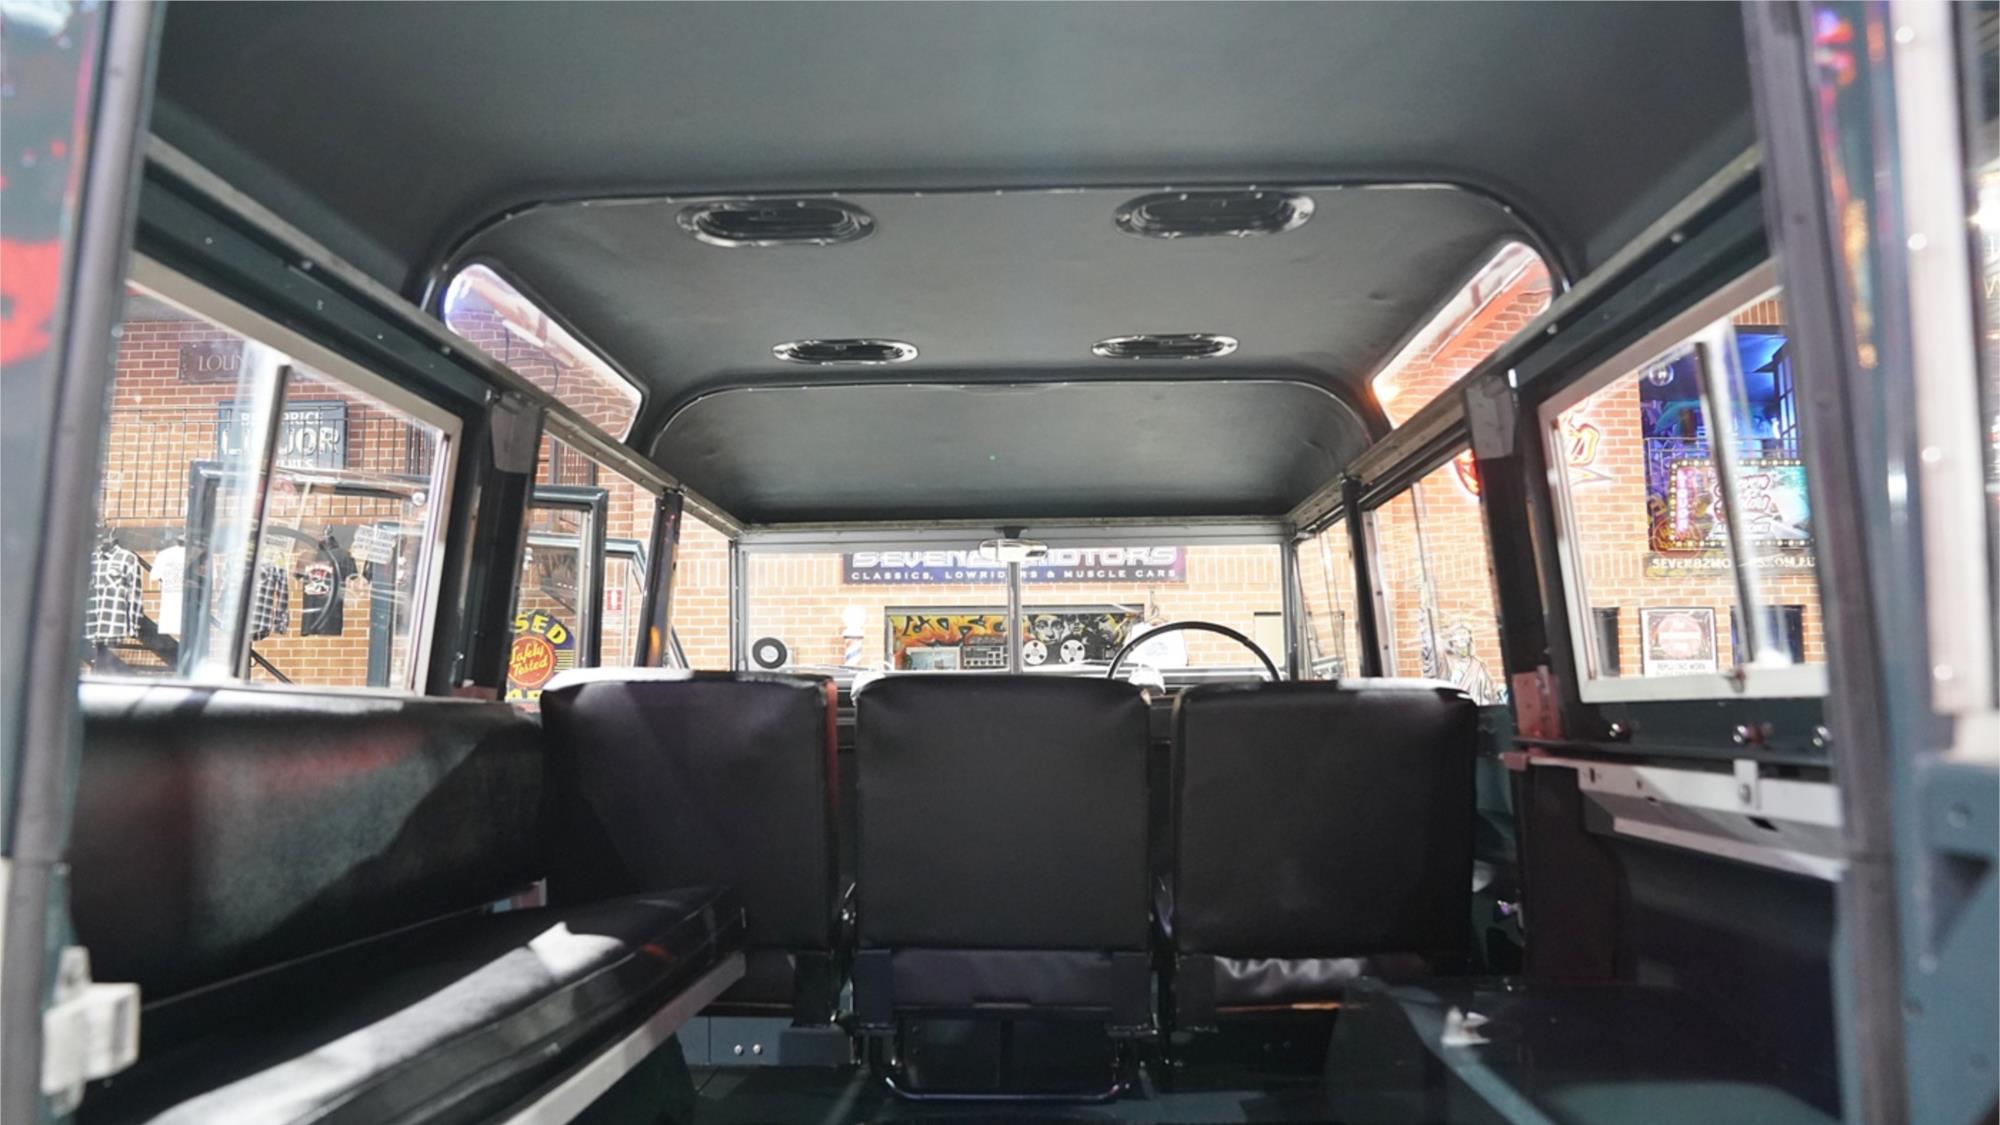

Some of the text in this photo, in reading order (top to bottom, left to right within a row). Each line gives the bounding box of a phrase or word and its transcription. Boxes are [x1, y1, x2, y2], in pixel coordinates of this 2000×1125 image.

[851, 571, 934, 580] CLASSICS,
[945, 570, 1038, 580] LOWRIDRS
[1063, 569, 1127, 578] MUSCLE
[1135, 568, 1176, 578] CARS
[512, 611, 567, 644] SED
[512, 655, 548, 677] Tested
